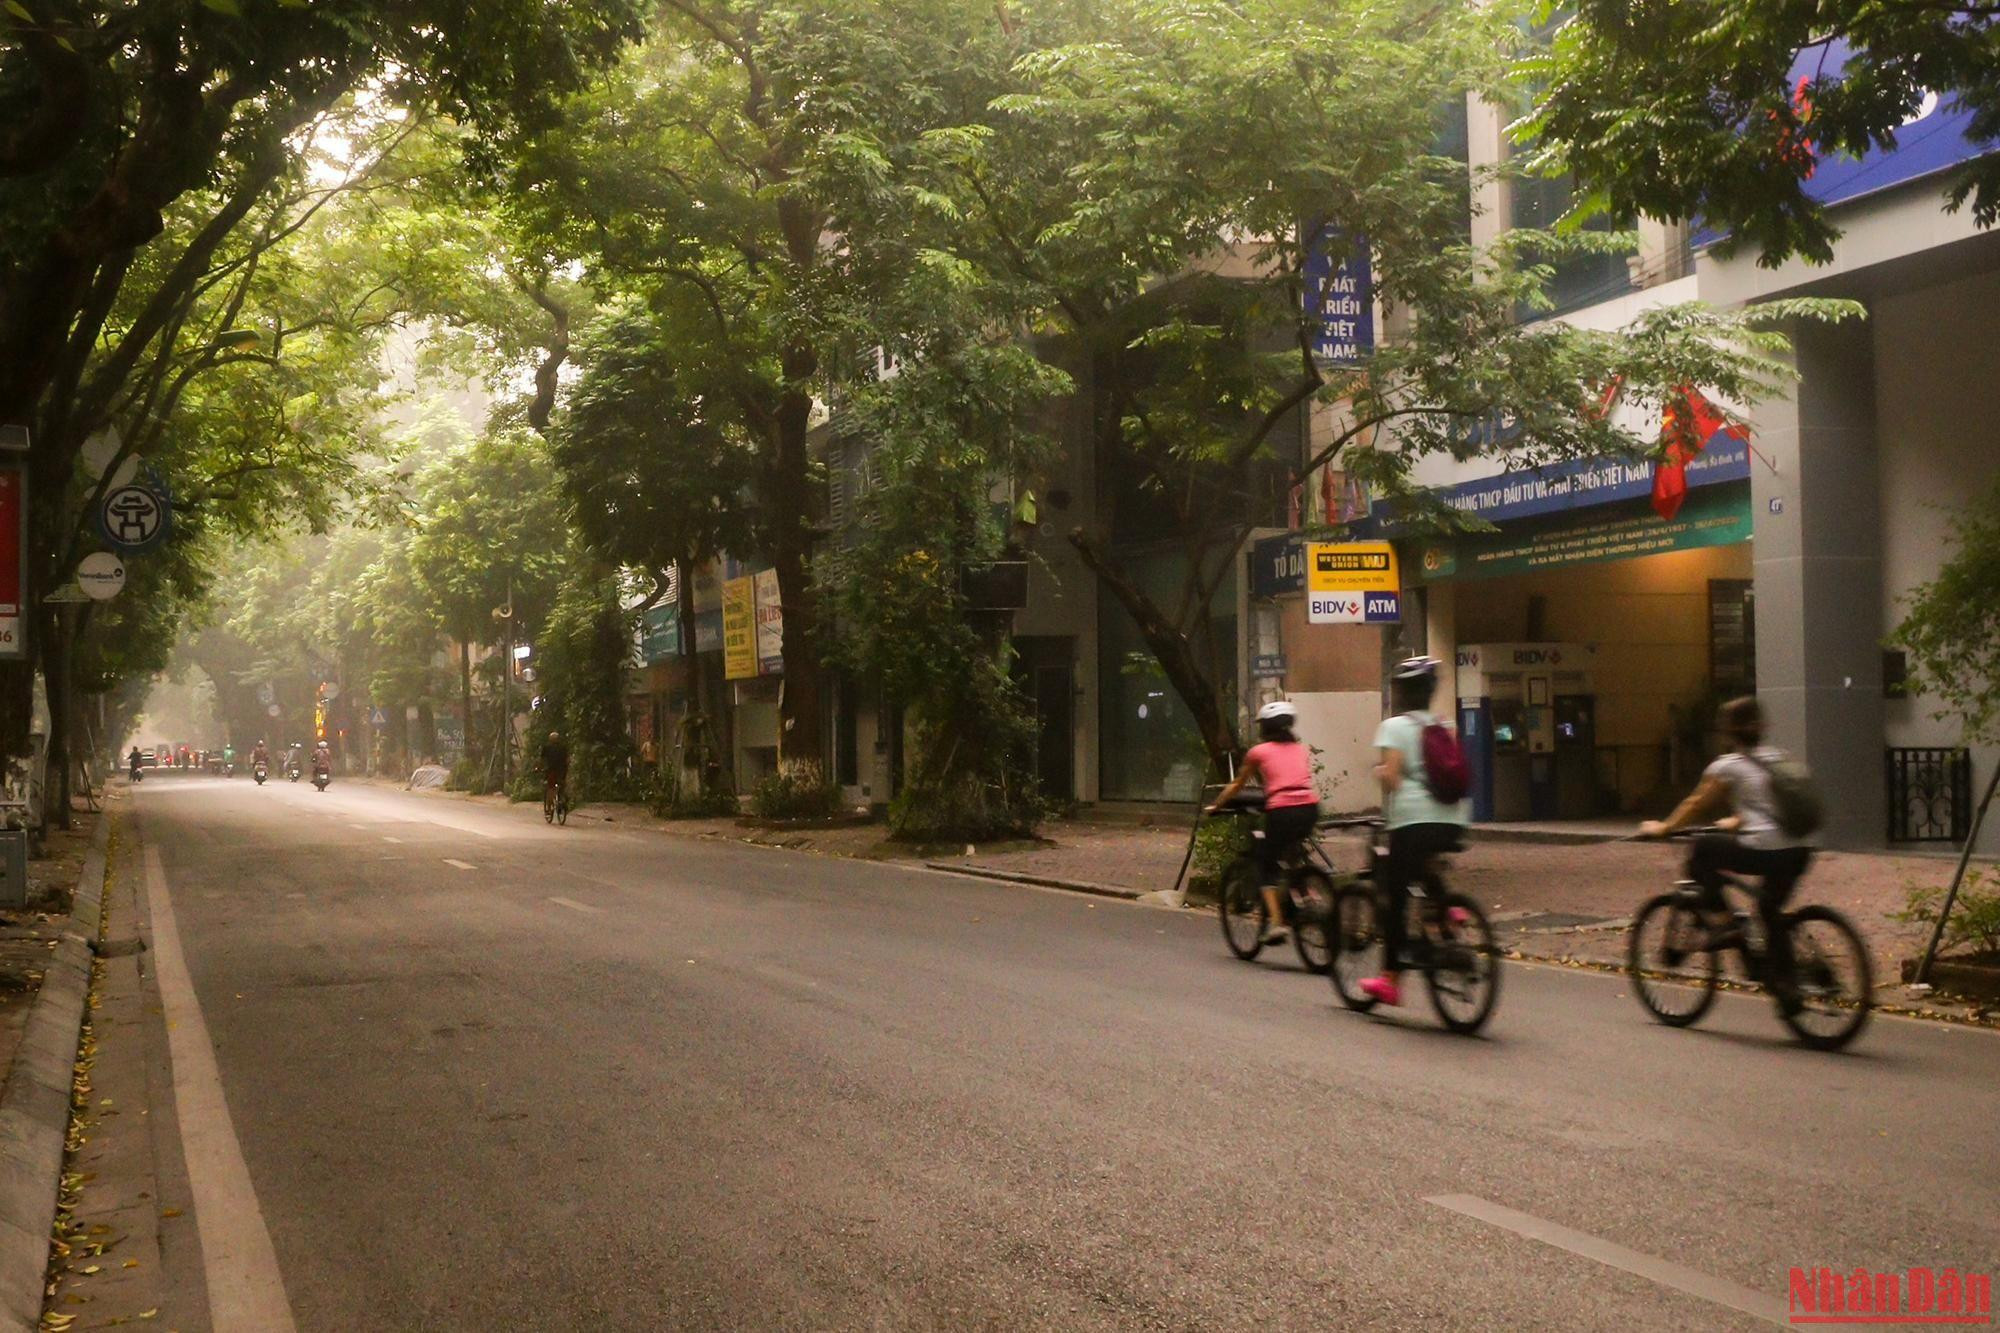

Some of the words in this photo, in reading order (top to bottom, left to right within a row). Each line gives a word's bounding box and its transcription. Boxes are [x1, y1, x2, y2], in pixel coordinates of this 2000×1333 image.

[1479, 491, 1502, 509] TMCP
[1625, 461, 1649, 483] NAM
[1312, 601, 1345, 614] BIDV
[1367, 599, 1397, 614] ATM
[1513, 649, 1548, 664] BIDV
